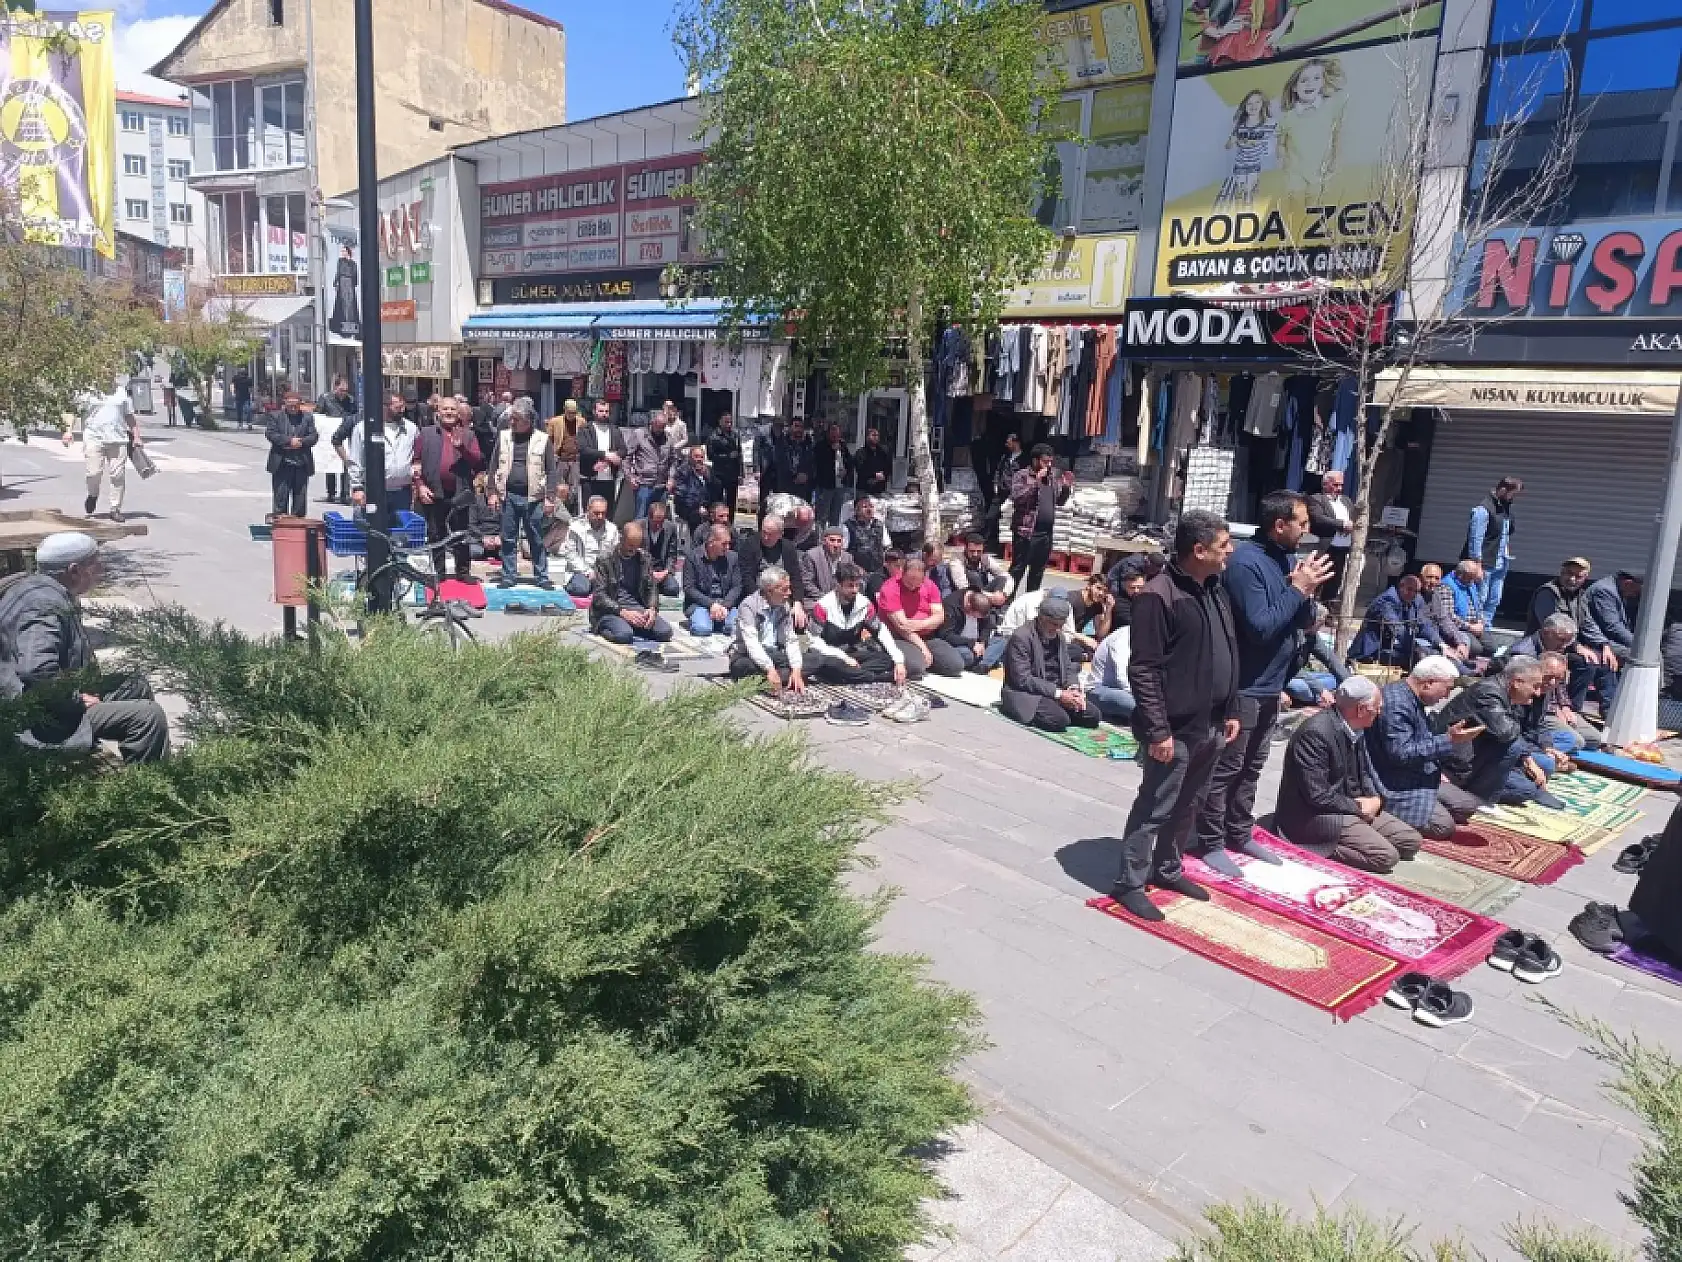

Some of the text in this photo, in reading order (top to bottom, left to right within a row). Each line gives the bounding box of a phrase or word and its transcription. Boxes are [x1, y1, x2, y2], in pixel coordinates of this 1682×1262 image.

[482, 180, 615, 217] SÜMER HALICILIK
[1169, 202, 1403, 248] MODA ZEN
[1177, 259, 1230, 278] BAYAN
[1232, 258, 1246, 275] &
[1250, 253, 1309, 279] ÇOCUK
[1127, 303, 1389, 346] MODA ZEN
[1525, 389, 1643, 406] KUYUMCULUK
